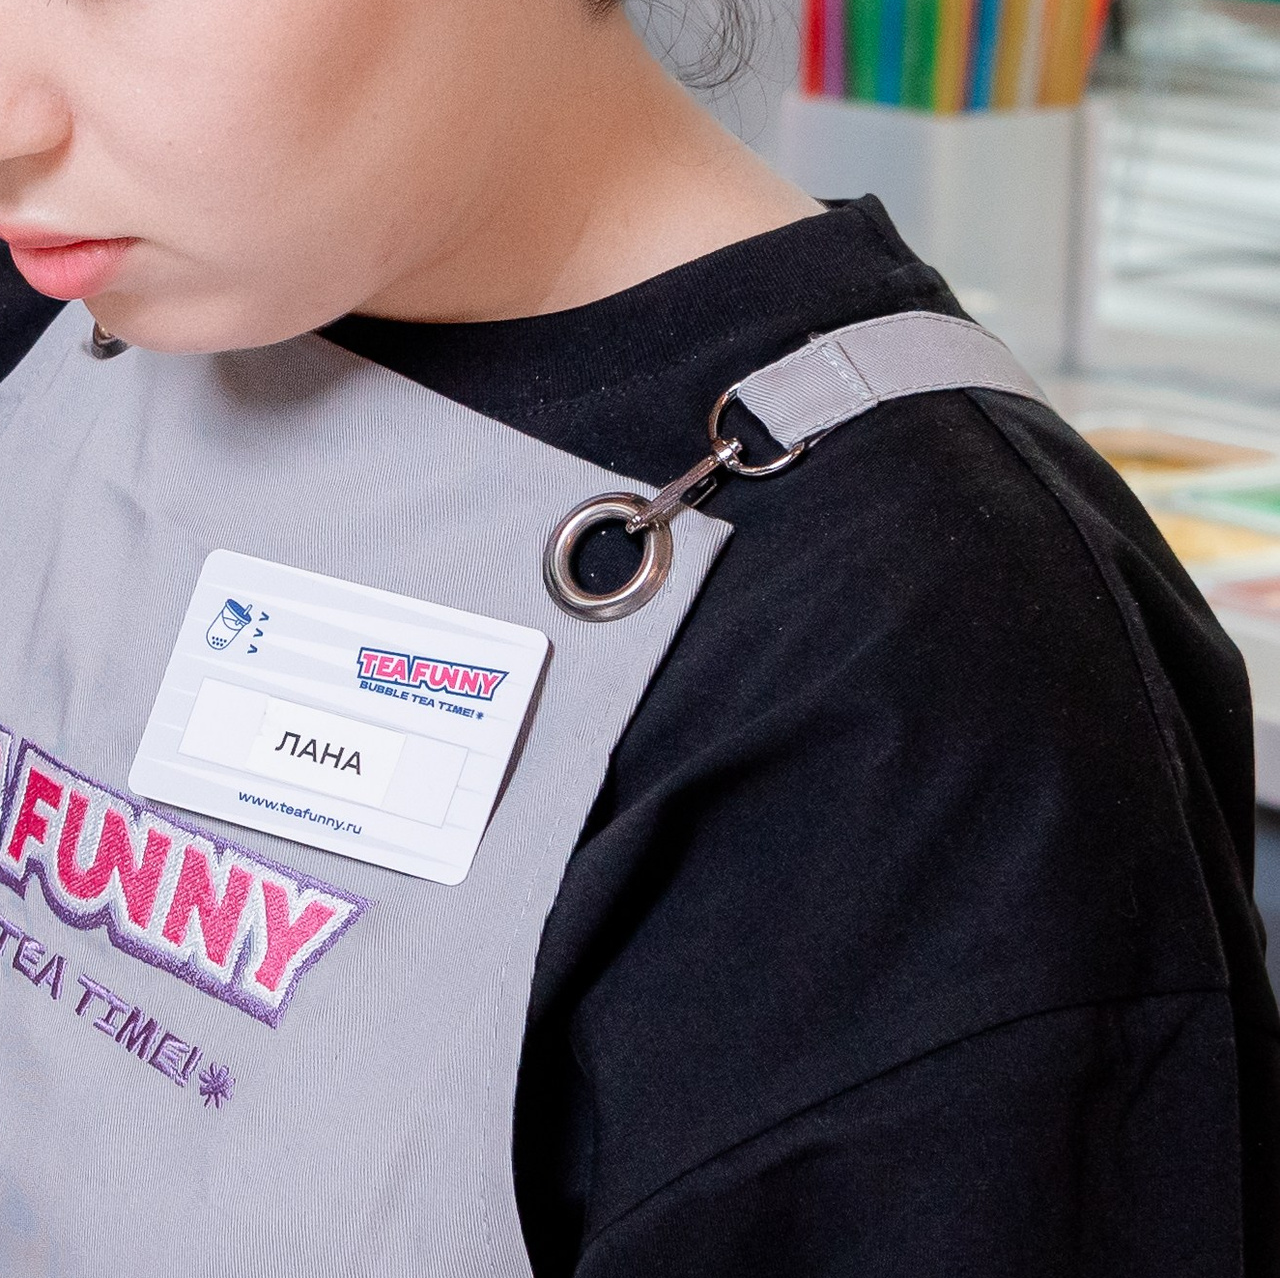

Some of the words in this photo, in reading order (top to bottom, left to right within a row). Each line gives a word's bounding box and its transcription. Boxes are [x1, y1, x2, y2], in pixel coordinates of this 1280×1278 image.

[361, 652, 407, 681] TEA
[411, 661, 500, 696] FUNNY
[359, 680, 410, 701] BUBBLE
[411, 693, 435, 708] TEA
[438, 700, 475, 719] TIME!
[274, 730, 362, 776] ЛАНА
[238, 790, 363, 836] www.teafunny.ru
[6, 765, 337, 994] FUNNY
[75, 971, 203, 1088] TIME!
